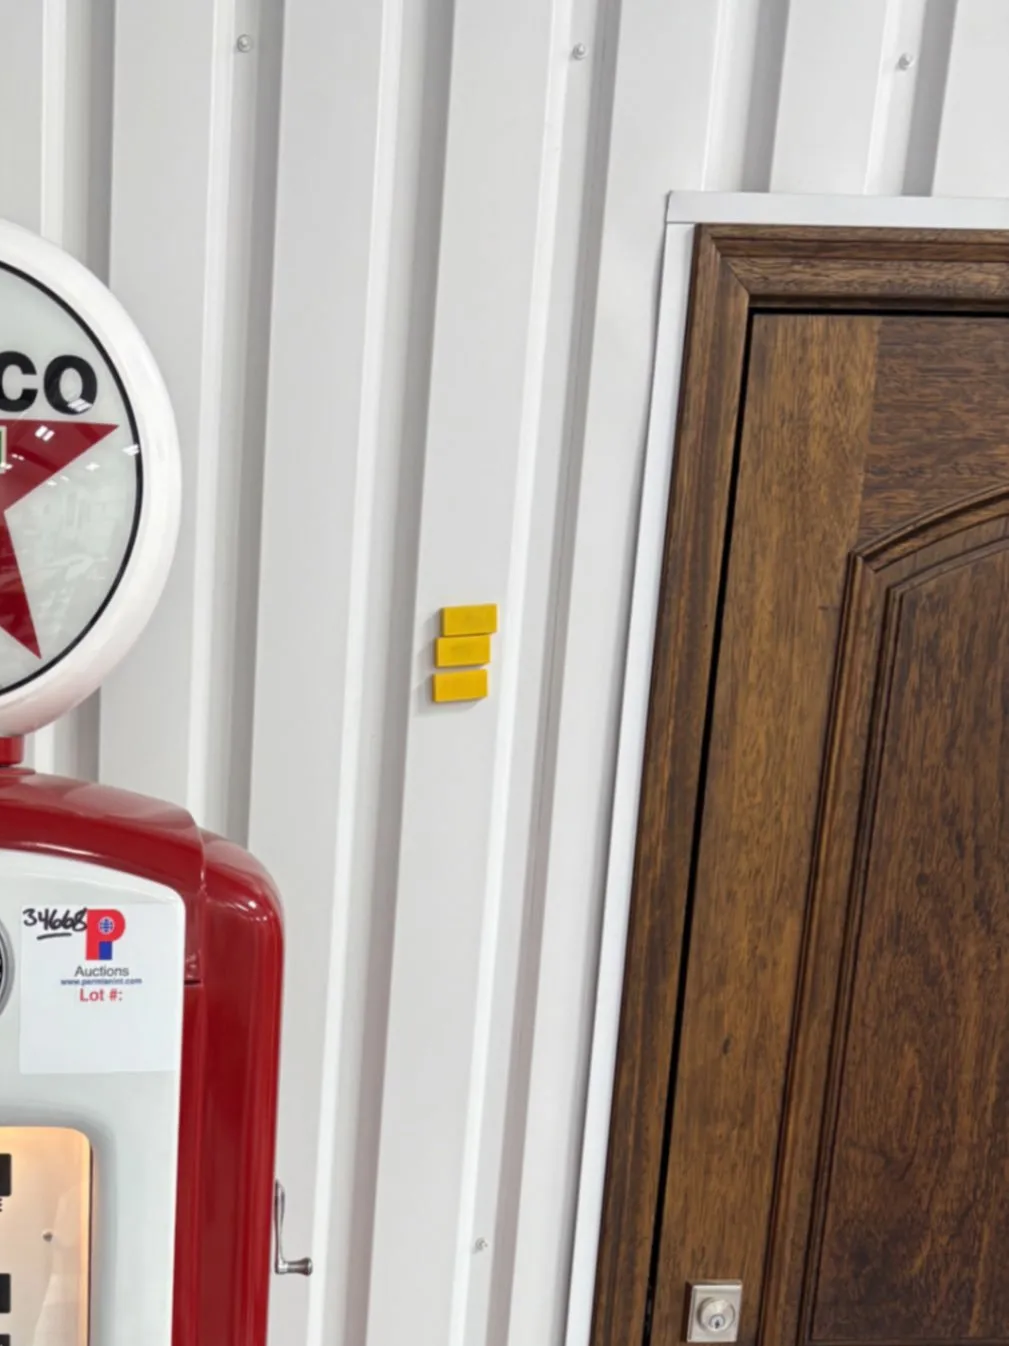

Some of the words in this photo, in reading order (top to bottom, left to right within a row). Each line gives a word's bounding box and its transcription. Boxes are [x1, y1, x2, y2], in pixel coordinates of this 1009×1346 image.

[22, 906, 89, 932] 34668
[74, 966, 130, 977] Auctions
[79, 988, 105, 1002] Lot
